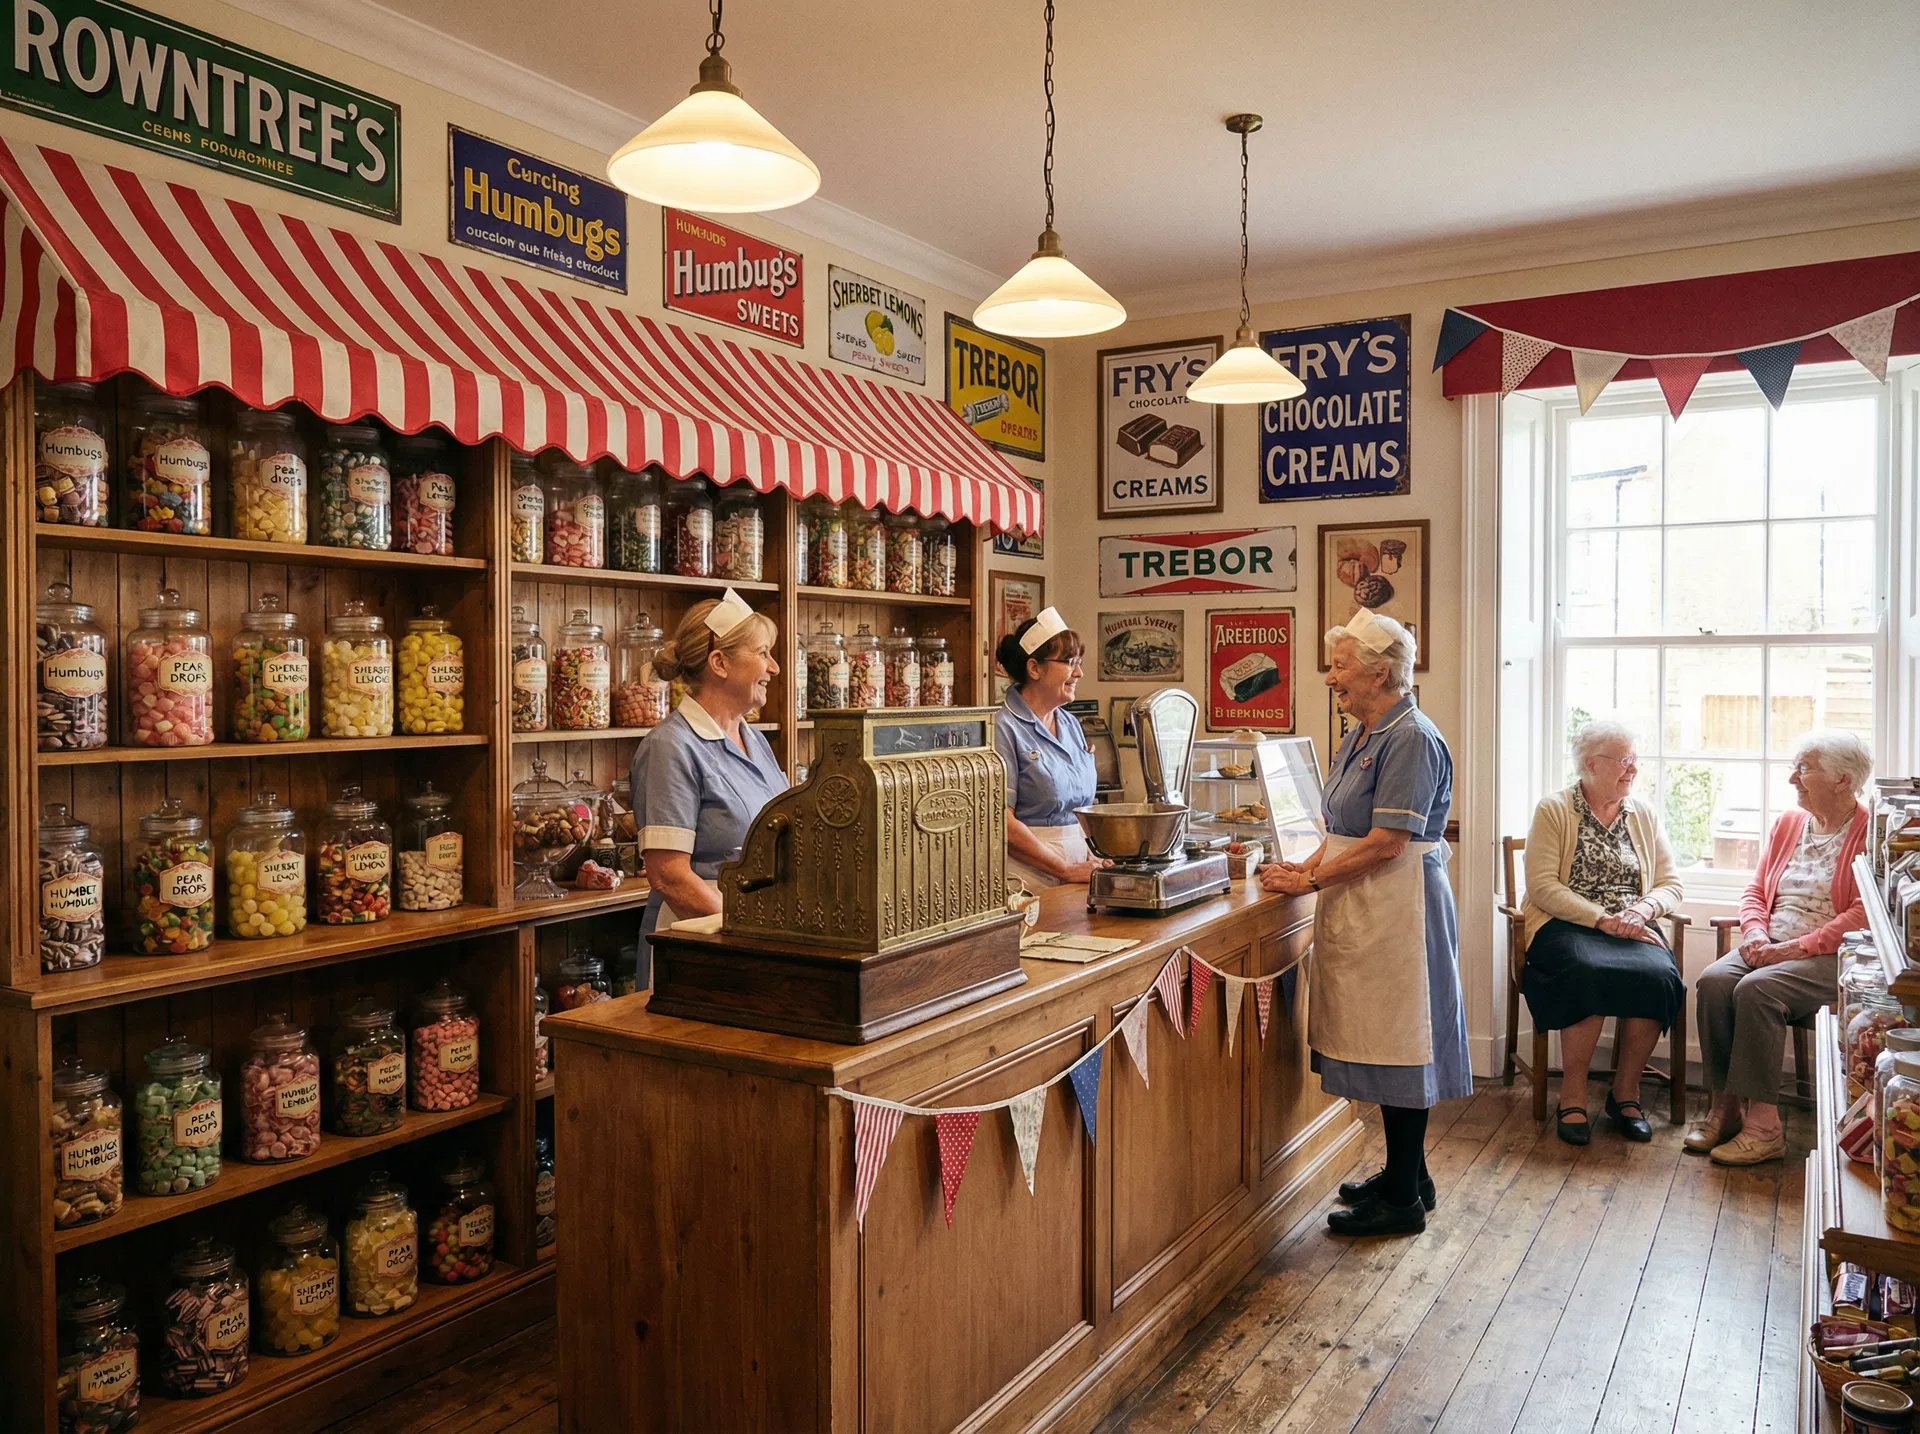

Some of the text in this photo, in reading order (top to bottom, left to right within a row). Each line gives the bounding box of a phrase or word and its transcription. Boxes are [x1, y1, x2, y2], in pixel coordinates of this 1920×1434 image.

[14, 0, 387, 184] ROWNTREE'S
[464, 166, 620, 261] Humbugs
[737, 298, 799, 337] SWEETS
[833, 279, 924, 339] SHERBET LEMONS
[954, 338, 1040, 415] TREBOR
[1270, 331, 1397, 381] FRY'S
[1128, 396, 1189, 409] CHOCOLATE
[1264, 389, 1402, 433] CHOCOLATE
[1266, 440, 1400, 486] CREAMS
[1113, 475, 1208, 499] CREAMS
[1118, 546, 1273, 579] TREBOR
[48, 667, 104, 681] Humbugs
[176, 874, 203, 885] PEAR
[191, 1111, 216, 1126] PEAR
